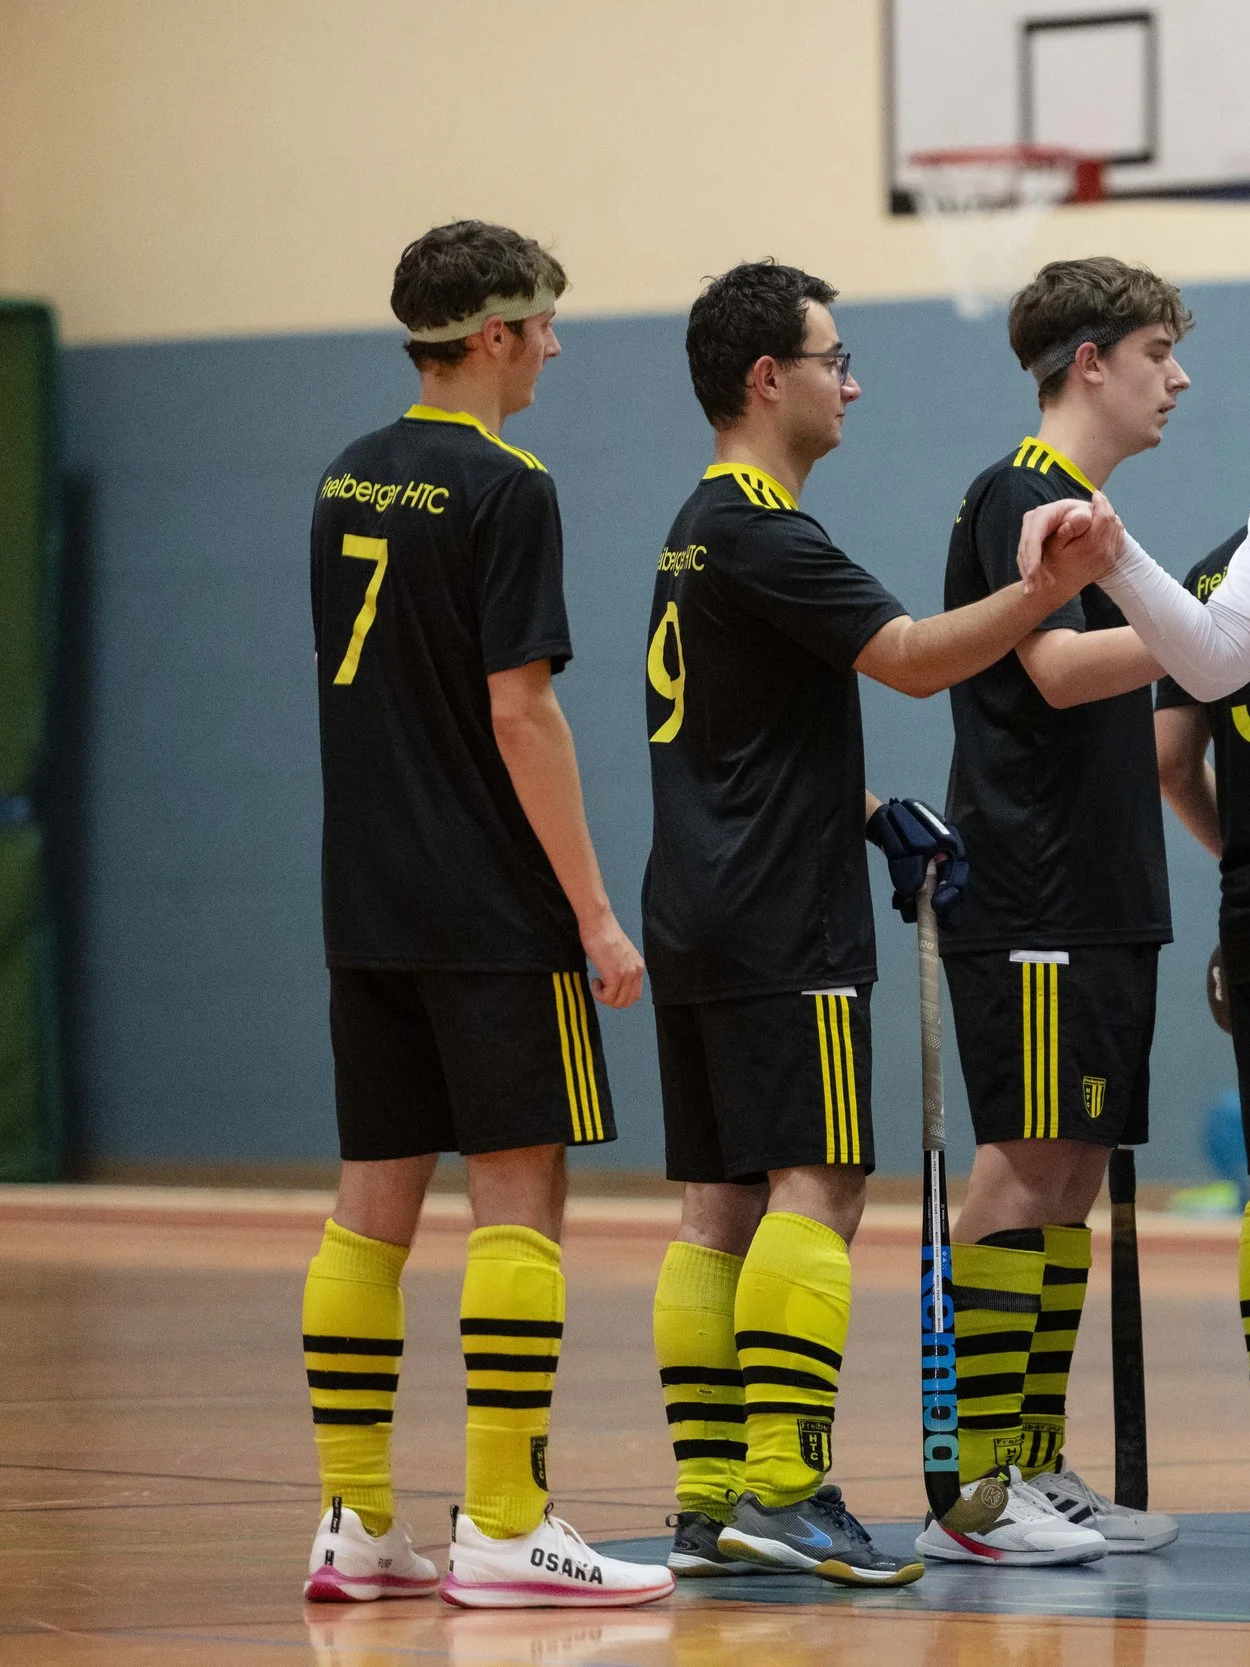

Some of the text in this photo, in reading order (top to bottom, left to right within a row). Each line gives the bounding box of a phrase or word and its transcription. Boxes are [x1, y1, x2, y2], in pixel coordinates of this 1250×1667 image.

[401, 481, 449, 514] HTC
[333, 533, 388, 686] 7
[648, 601, 686, 743] 9
[809, 1434, 819, 1461] HTC
